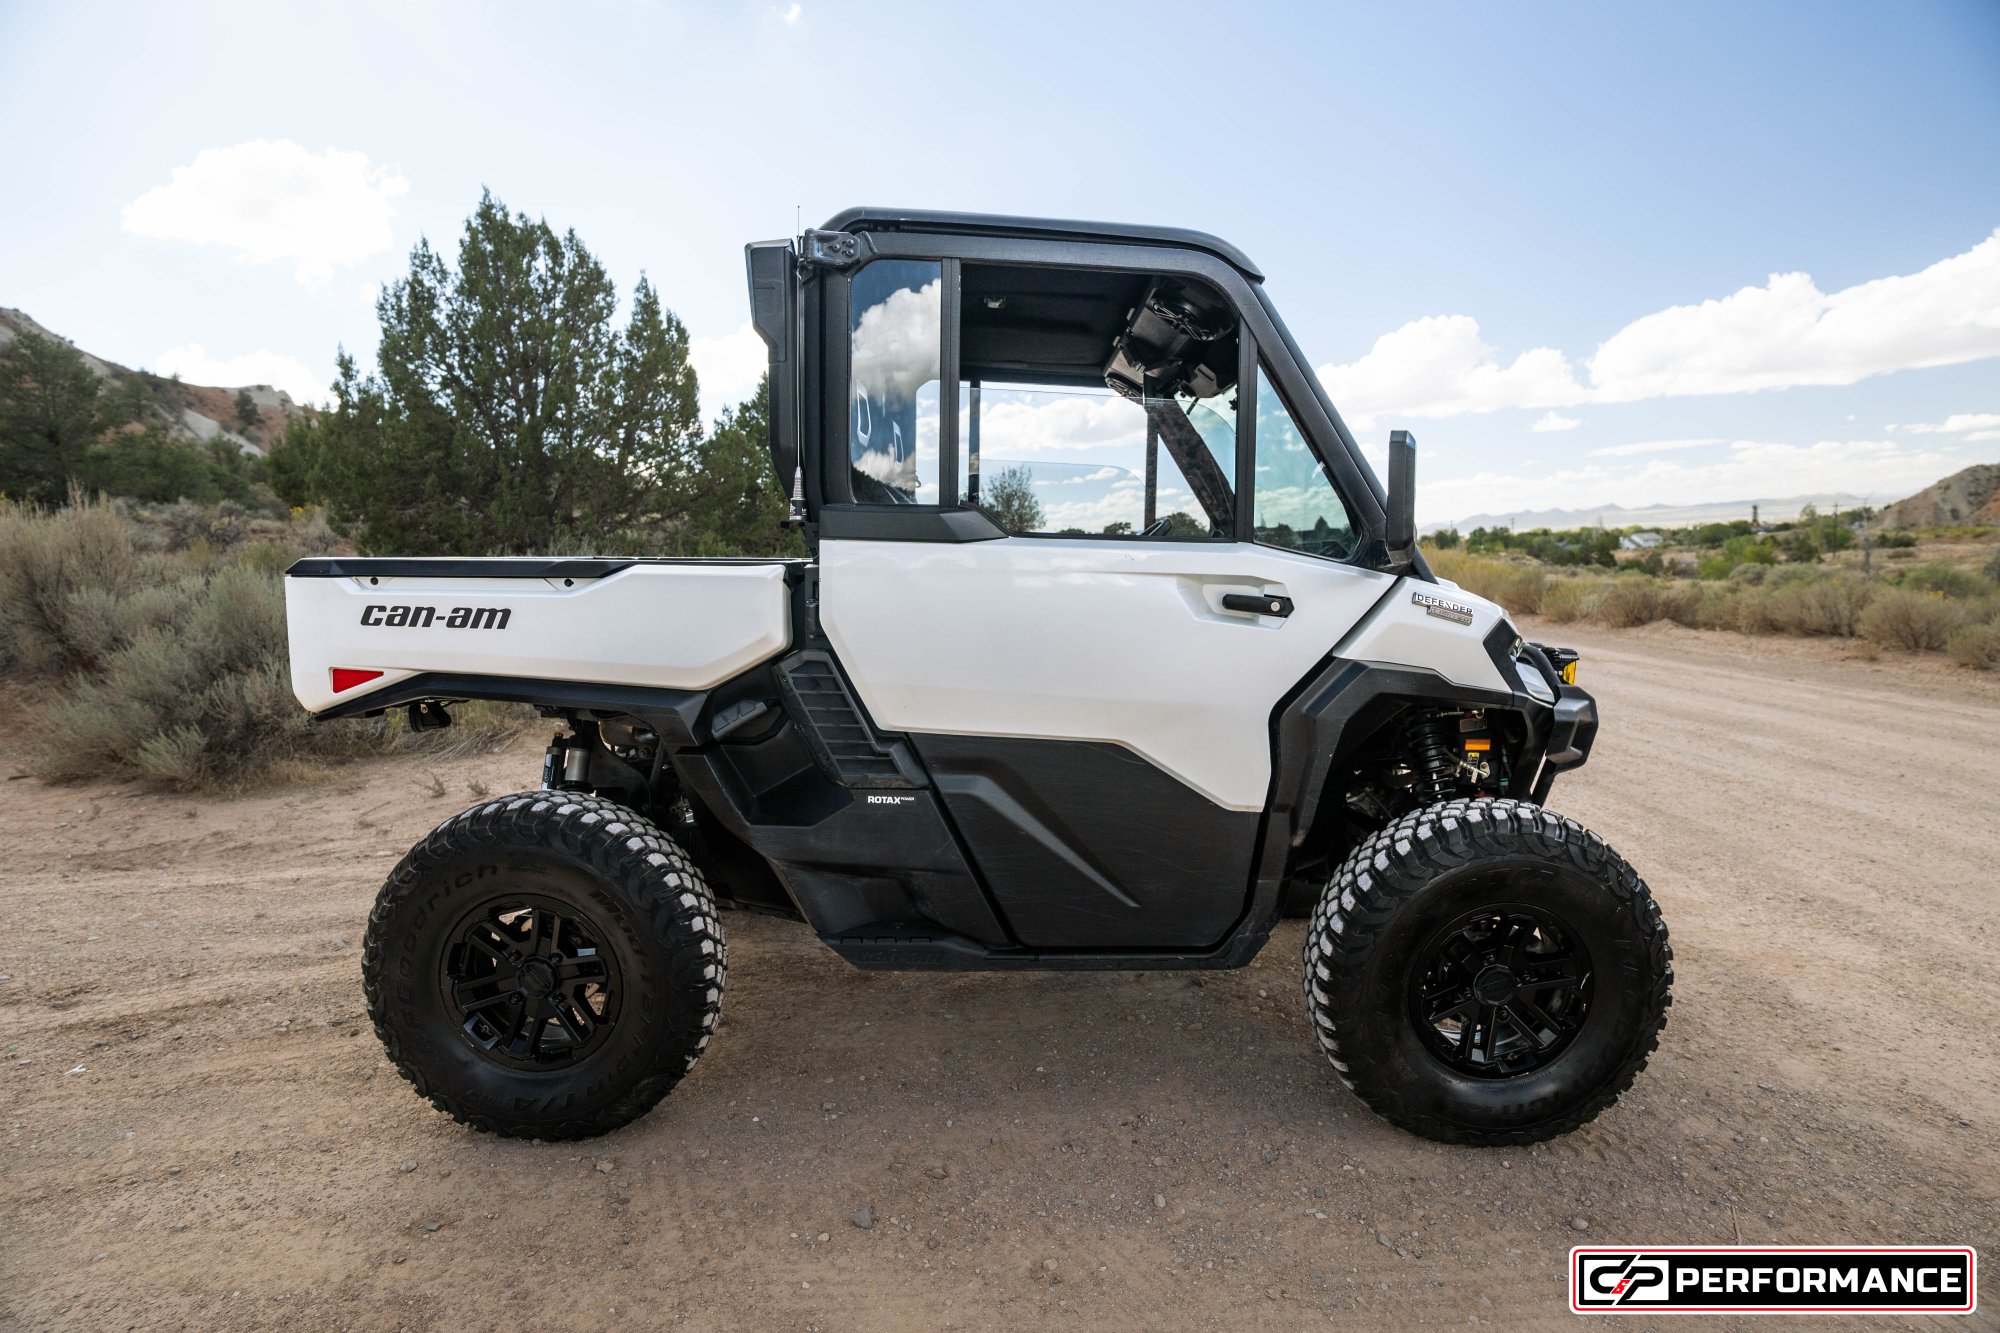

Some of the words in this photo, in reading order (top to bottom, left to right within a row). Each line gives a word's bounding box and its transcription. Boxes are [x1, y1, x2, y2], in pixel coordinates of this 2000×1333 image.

[1416, 593, 1474, 615] DEFENDER
[360, 604, 512, 630] can-am
[867, 795, 901, 804] ROTAX
